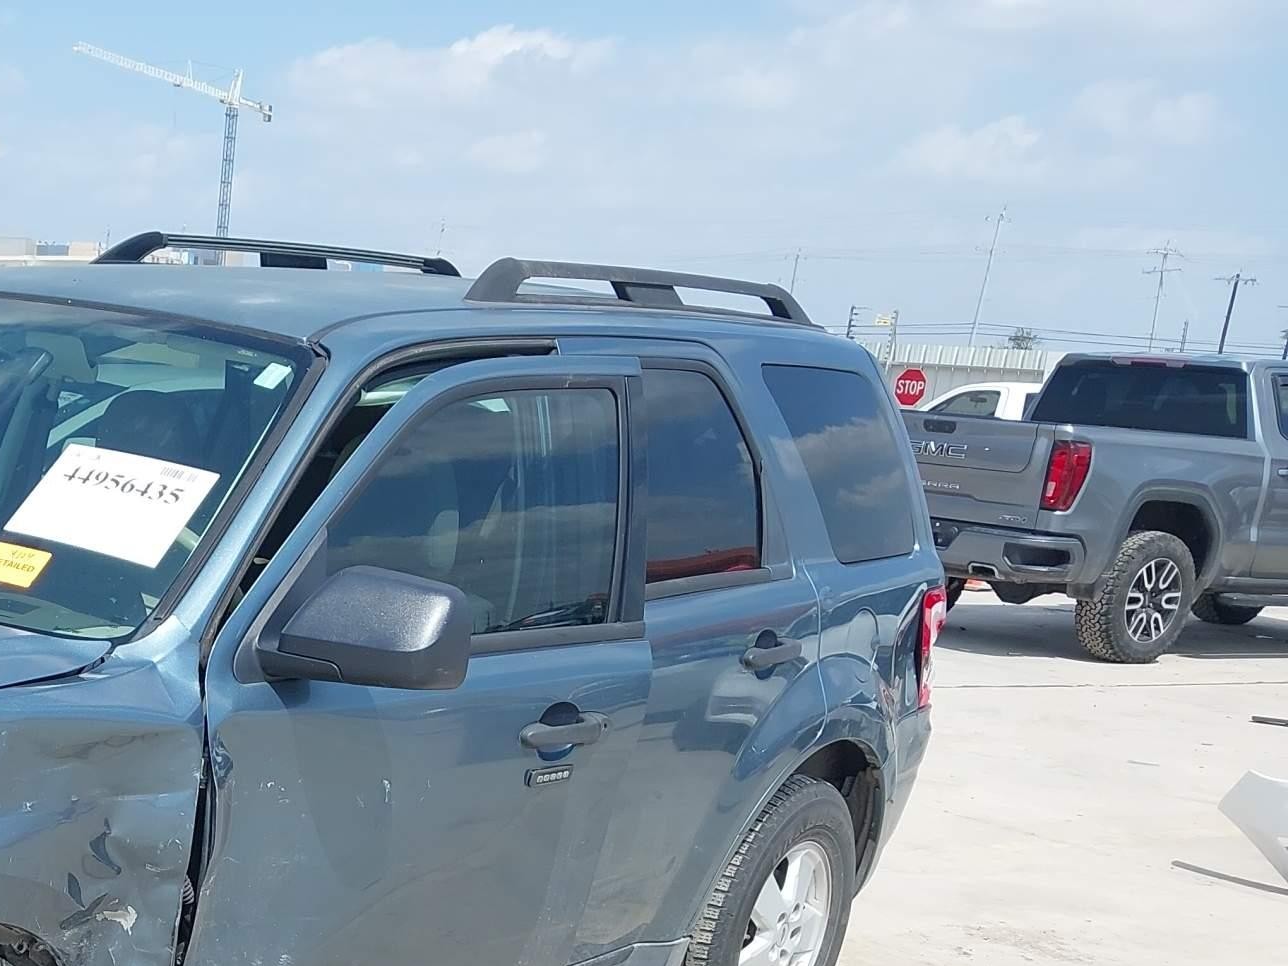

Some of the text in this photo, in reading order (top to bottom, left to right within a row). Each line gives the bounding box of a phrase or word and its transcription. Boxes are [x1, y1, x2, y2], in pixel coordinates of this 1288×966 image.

[896, 379, 925, 396] STOP
[910, 440, 968, 460] GMC
[64, 466, 185, 504] 44956435
